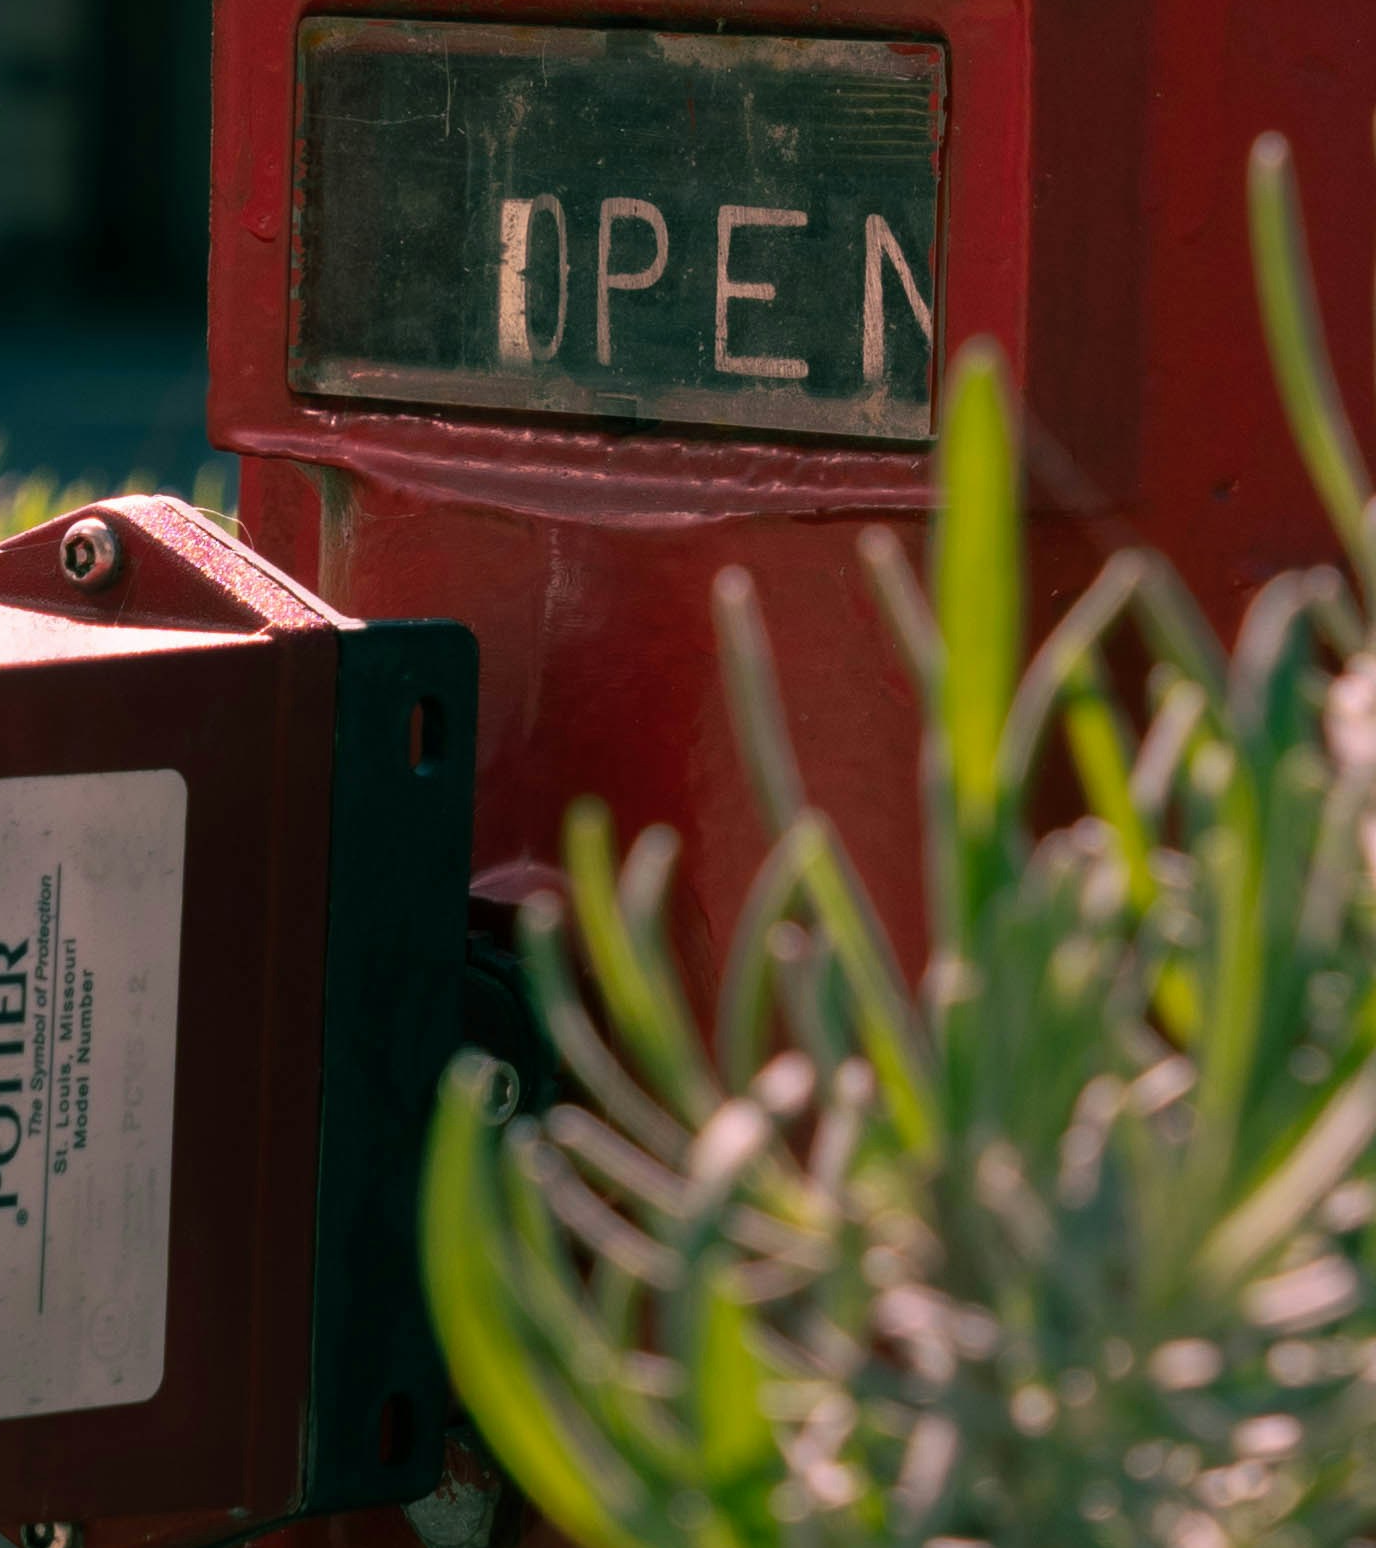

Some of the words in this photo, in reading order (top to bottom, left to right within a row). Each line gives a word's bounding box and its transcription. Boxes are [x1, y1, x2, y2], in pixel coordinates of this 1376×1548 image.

[500, 194, 935, 382] OPEN
[35, 874, 54, 981] Protection
[34, 987, 49, 1007] of
[60, 939, 77, 1041] Missouri
[78, 969, 95, 1064] Number
[30, 1014, 48, 1092] Symbol
[56, 1054, 74, 1128] Louis,
[28, 1099, 44, 1138] The
[73, 1076, 91, 1150] Model
[54, 1141, 69, 1176] St.
